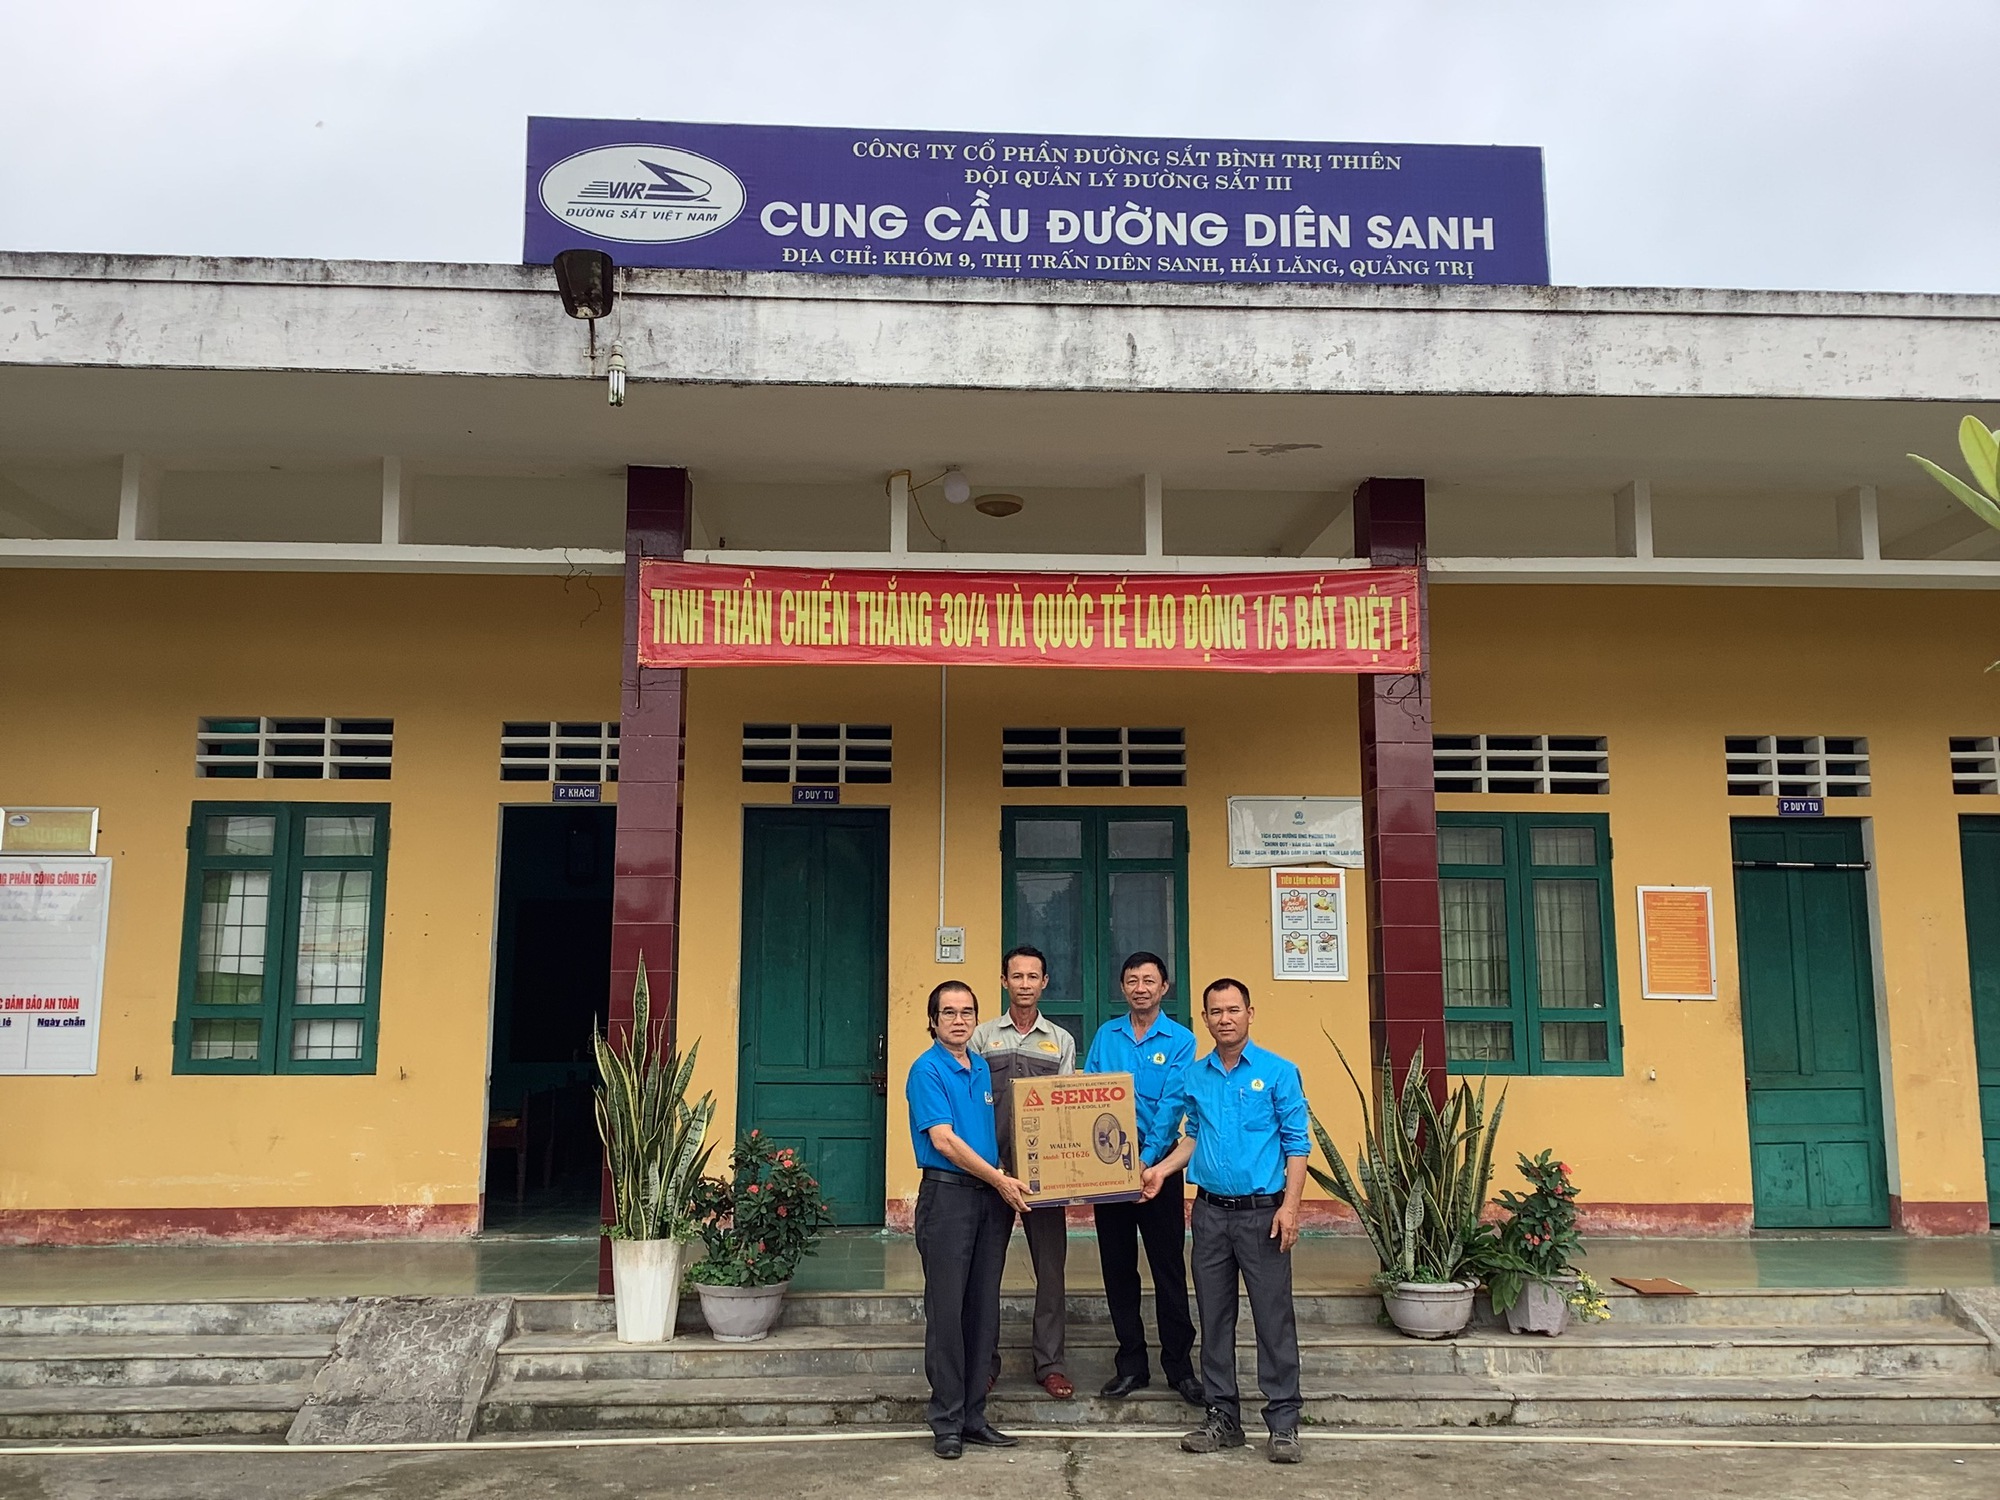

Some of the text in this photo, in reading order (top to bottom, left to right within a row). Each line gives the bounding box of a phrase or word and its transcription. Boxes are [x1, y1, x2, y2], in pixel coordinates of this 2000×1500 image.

[853, 138, 1401, 173] CÔNG TY CỔ PHẦN ĐƯỜNG SẮT BÌNH TRỊ THIÊN
[964, 165, 1292, 191] ĐỘI QUẢN LÝ ĐƯỜNG SẮT III
[609, 182, 647, 199] VNR
[565, 207, 718, 222] ĐƯỜNG SẮT VIỆT NAM
[760, 189, 1494, 250] CUNG CẦU ĐƯỜNG DIÊN SANH
[782, 245, 1474, 279] ĐỊA CHỈ: KHÓM 9, THỊ TRẤN DIÊN SANH, HẢI LĂNG, QUẢNG TRỊ
[651, 588, 704, 644] TINH
[711, 571, 772, 645] THẦN
[780, 573, 849, 646] CHIẾN
[857, 575, 932, 647] THẮNG
[939, 592, 989, 647] 30/4
[996, 583, 1026, 648] VÀ
[1033, 576, 1094, 654] QUỐC
[1101, 577, 1127, 648] TẾ
[1134, 594, 1176, 649] LAO
[1183, 584, 1247, 663] ĐỘNG
[1253, 595, 1289, 650] 1/5
[1295, 577, 1337, 650] BẤT
[1344, 584, 1392, 663] DIỆT
[1790, 802, 1806, 811] DUY
[44, 998, 56, 1010] AN
[58, 996, 79, 1010] TOÀN
[37, 1018, 61, 1027] Ngày
[1050, 1087, 1125, 1105] SENKO
[1060, 1151, 1090, 1159] TC1626
